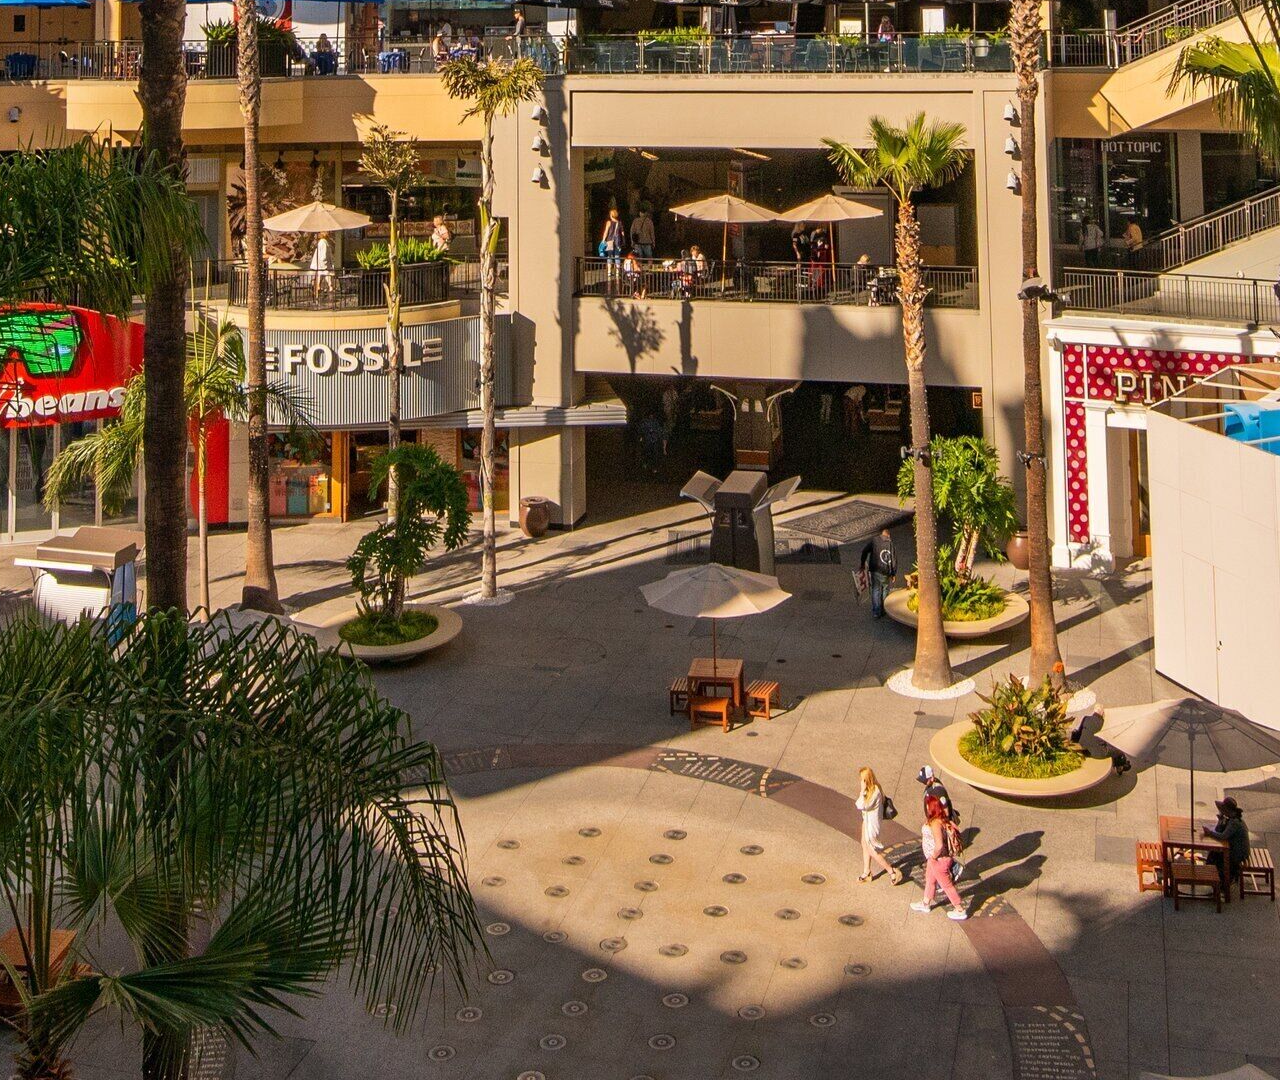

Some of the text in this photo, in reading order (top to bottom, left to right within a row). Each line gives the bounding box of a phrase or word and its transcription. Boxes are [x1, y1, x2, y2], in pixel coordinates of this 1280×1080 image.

[1101, 141, 1161, 153] HOT TOPIC
[284, 338, 421, 374] FOSSL
[5, 378, 127, 418] beans
[1114, 372, 1204, 405] PIN
